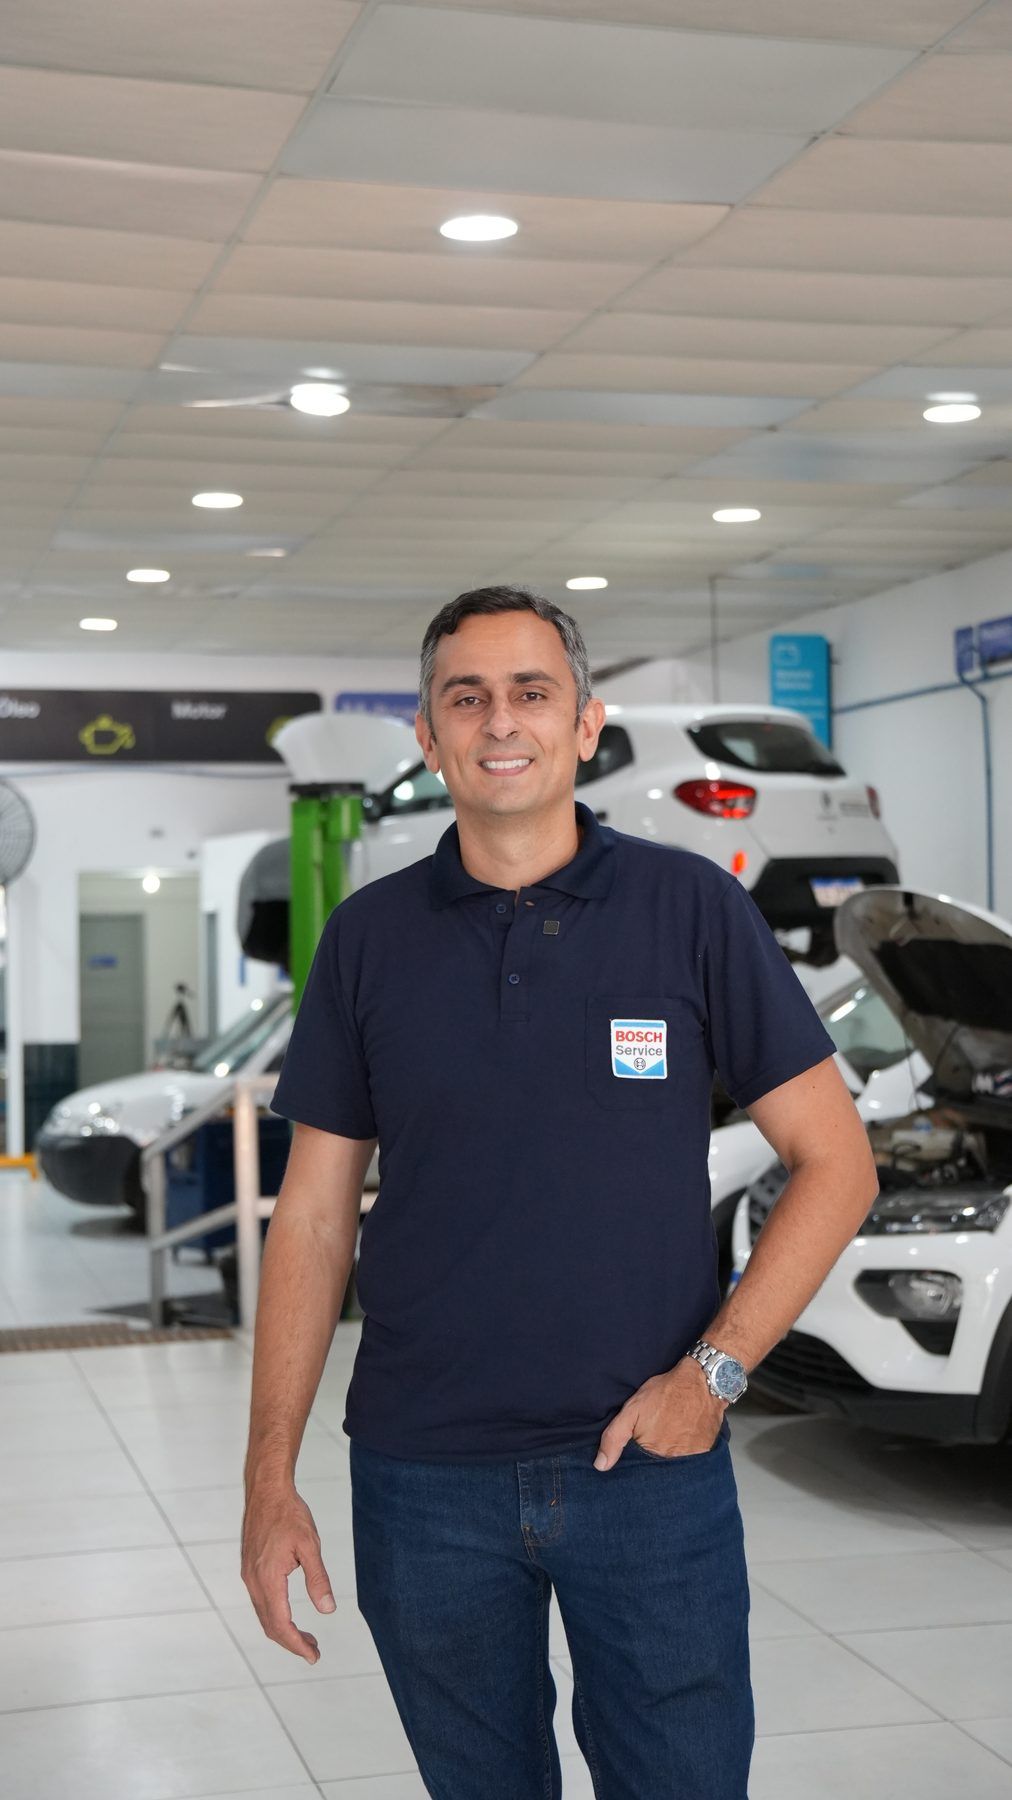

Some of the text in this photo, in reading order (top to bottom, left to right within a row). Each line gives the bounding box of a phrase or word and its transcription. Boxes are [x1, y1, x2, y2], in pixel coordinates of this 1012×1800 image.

[171, 701, 227, 720] Motor
[615, 1030, 663, 1043] BOSCH
[615, 1045, 663, 1056] Service
